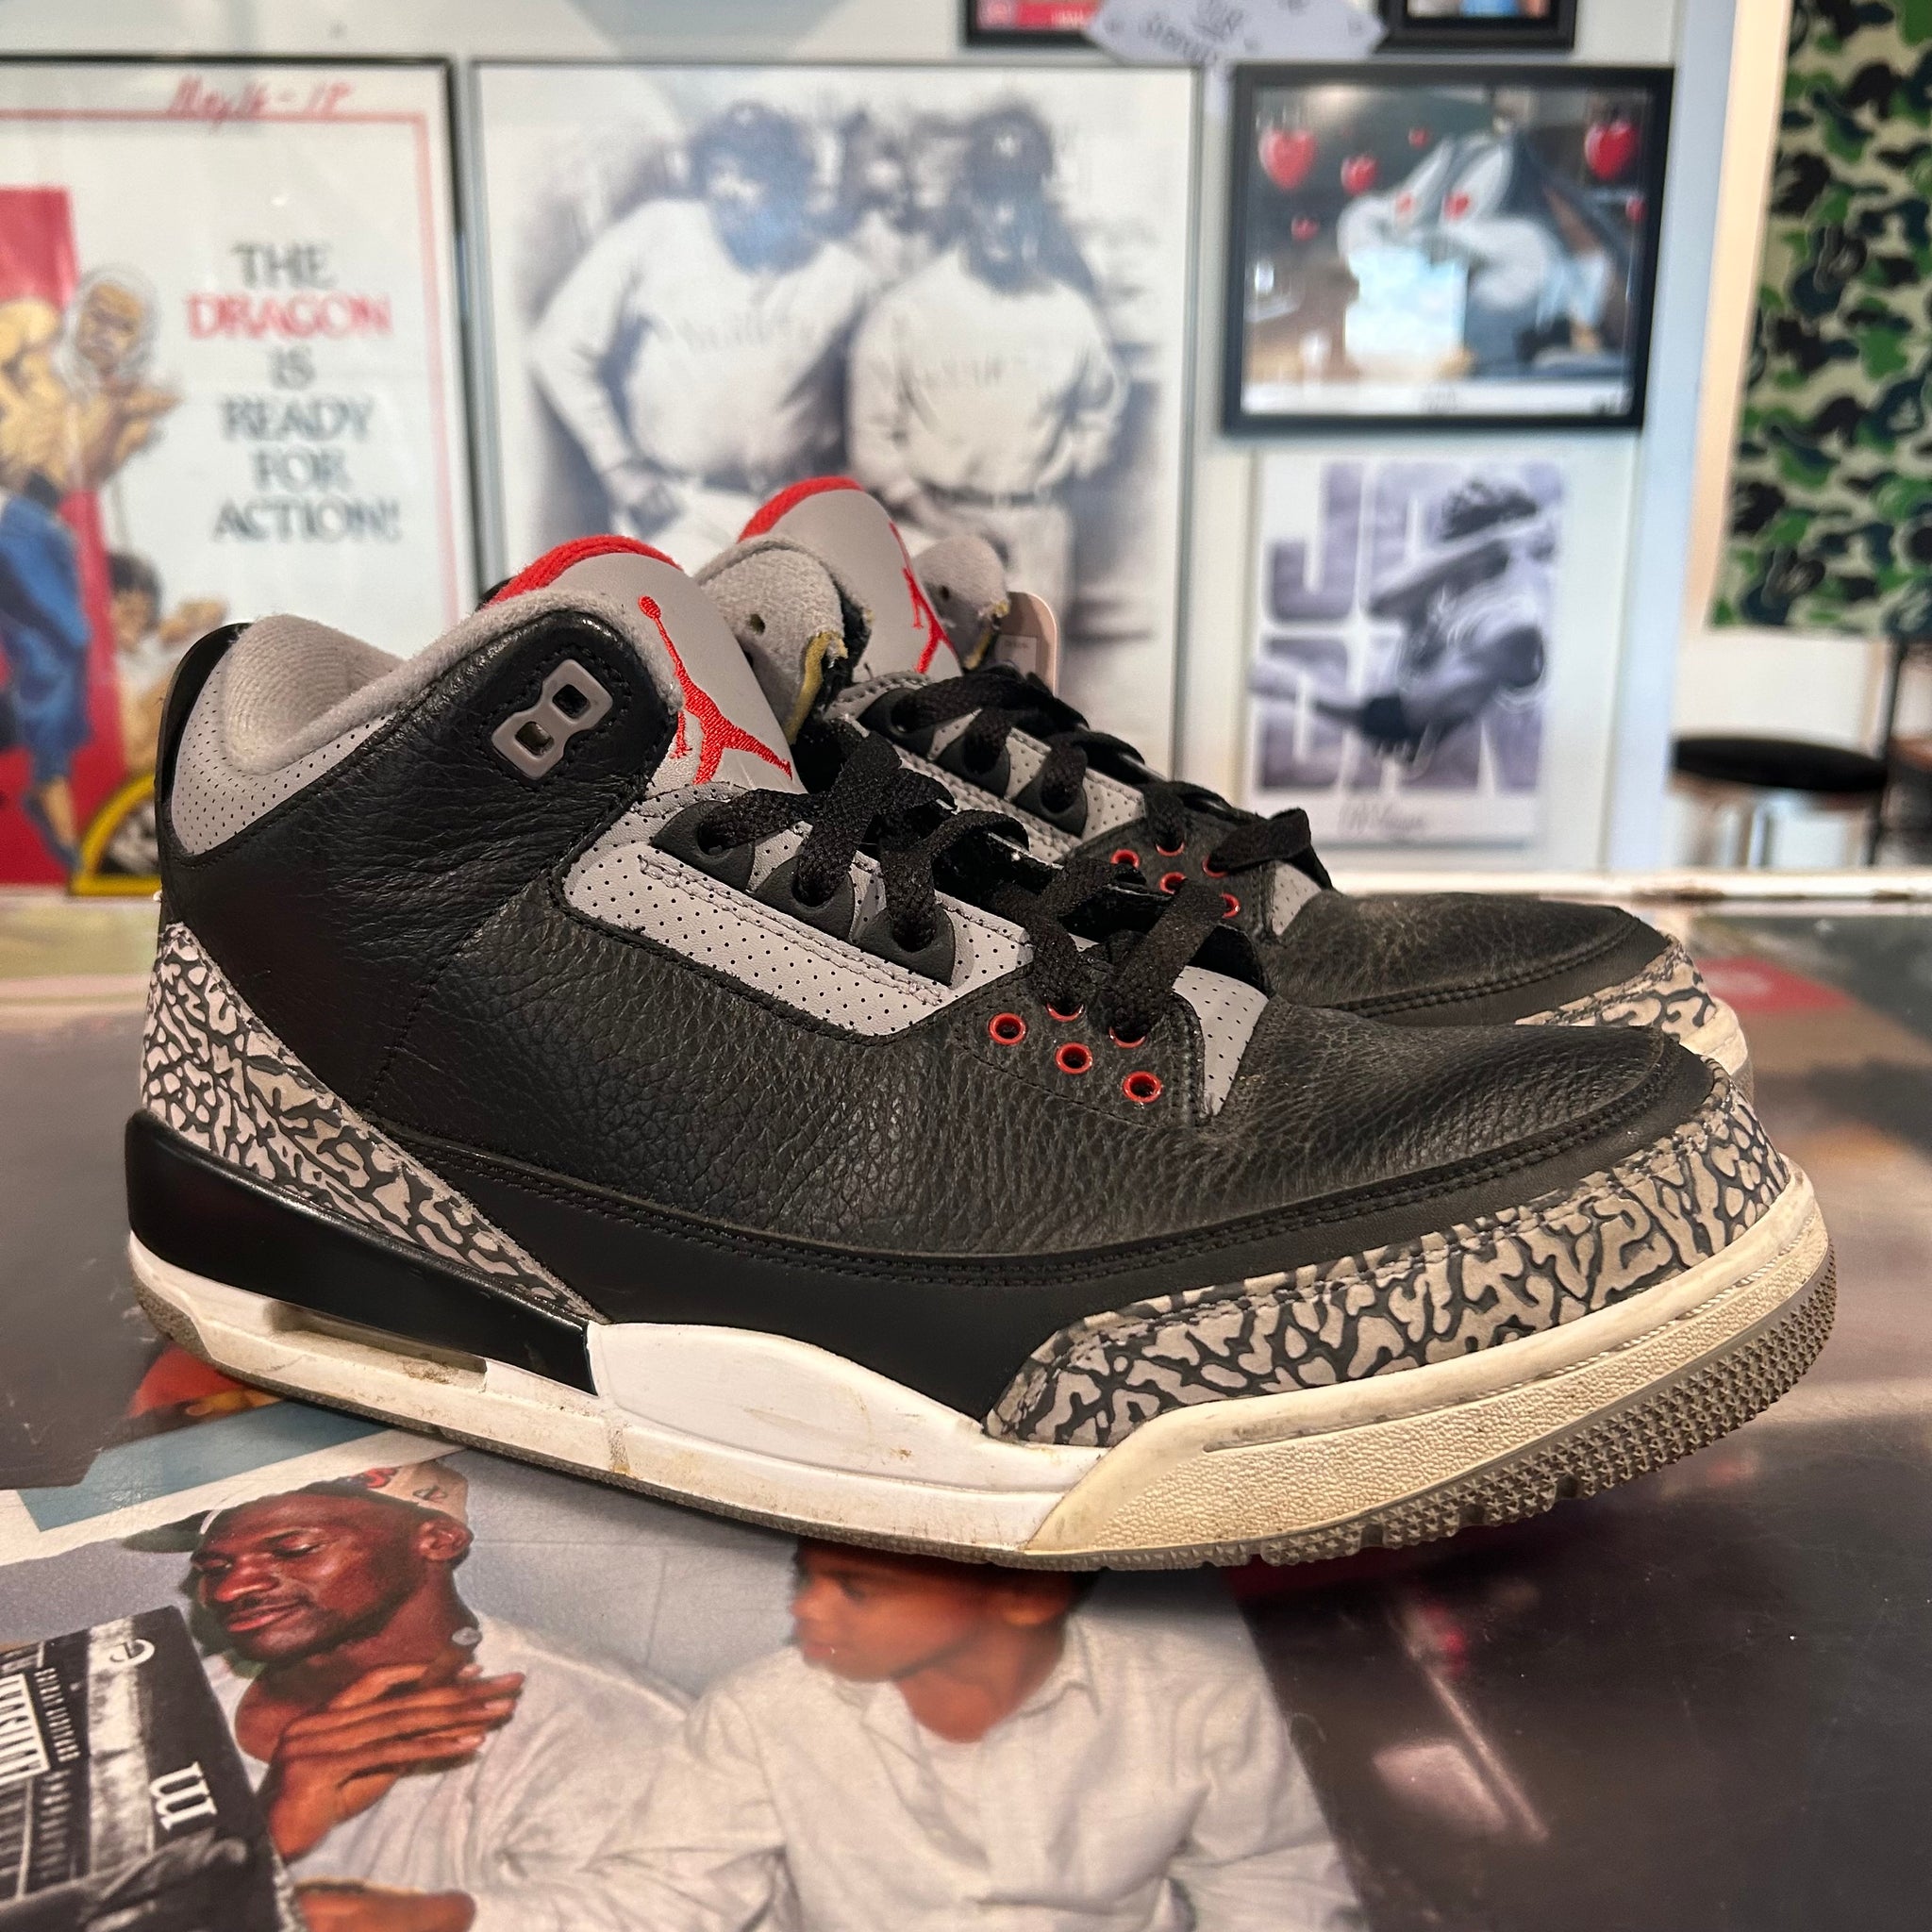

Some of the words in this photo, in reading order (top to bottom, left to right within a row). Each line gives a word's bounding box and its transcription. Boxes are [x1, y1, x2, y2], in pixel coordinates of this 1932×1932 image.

[234, 242, 334, 289] THE
[187, 293, 391, 340] DRAGON
[269, 347, 314, 389] IS
[222, 395, 372, 441] READY
[251, 449, 351, 491] FOR
[214, 500, 400, 542] ACTION!
